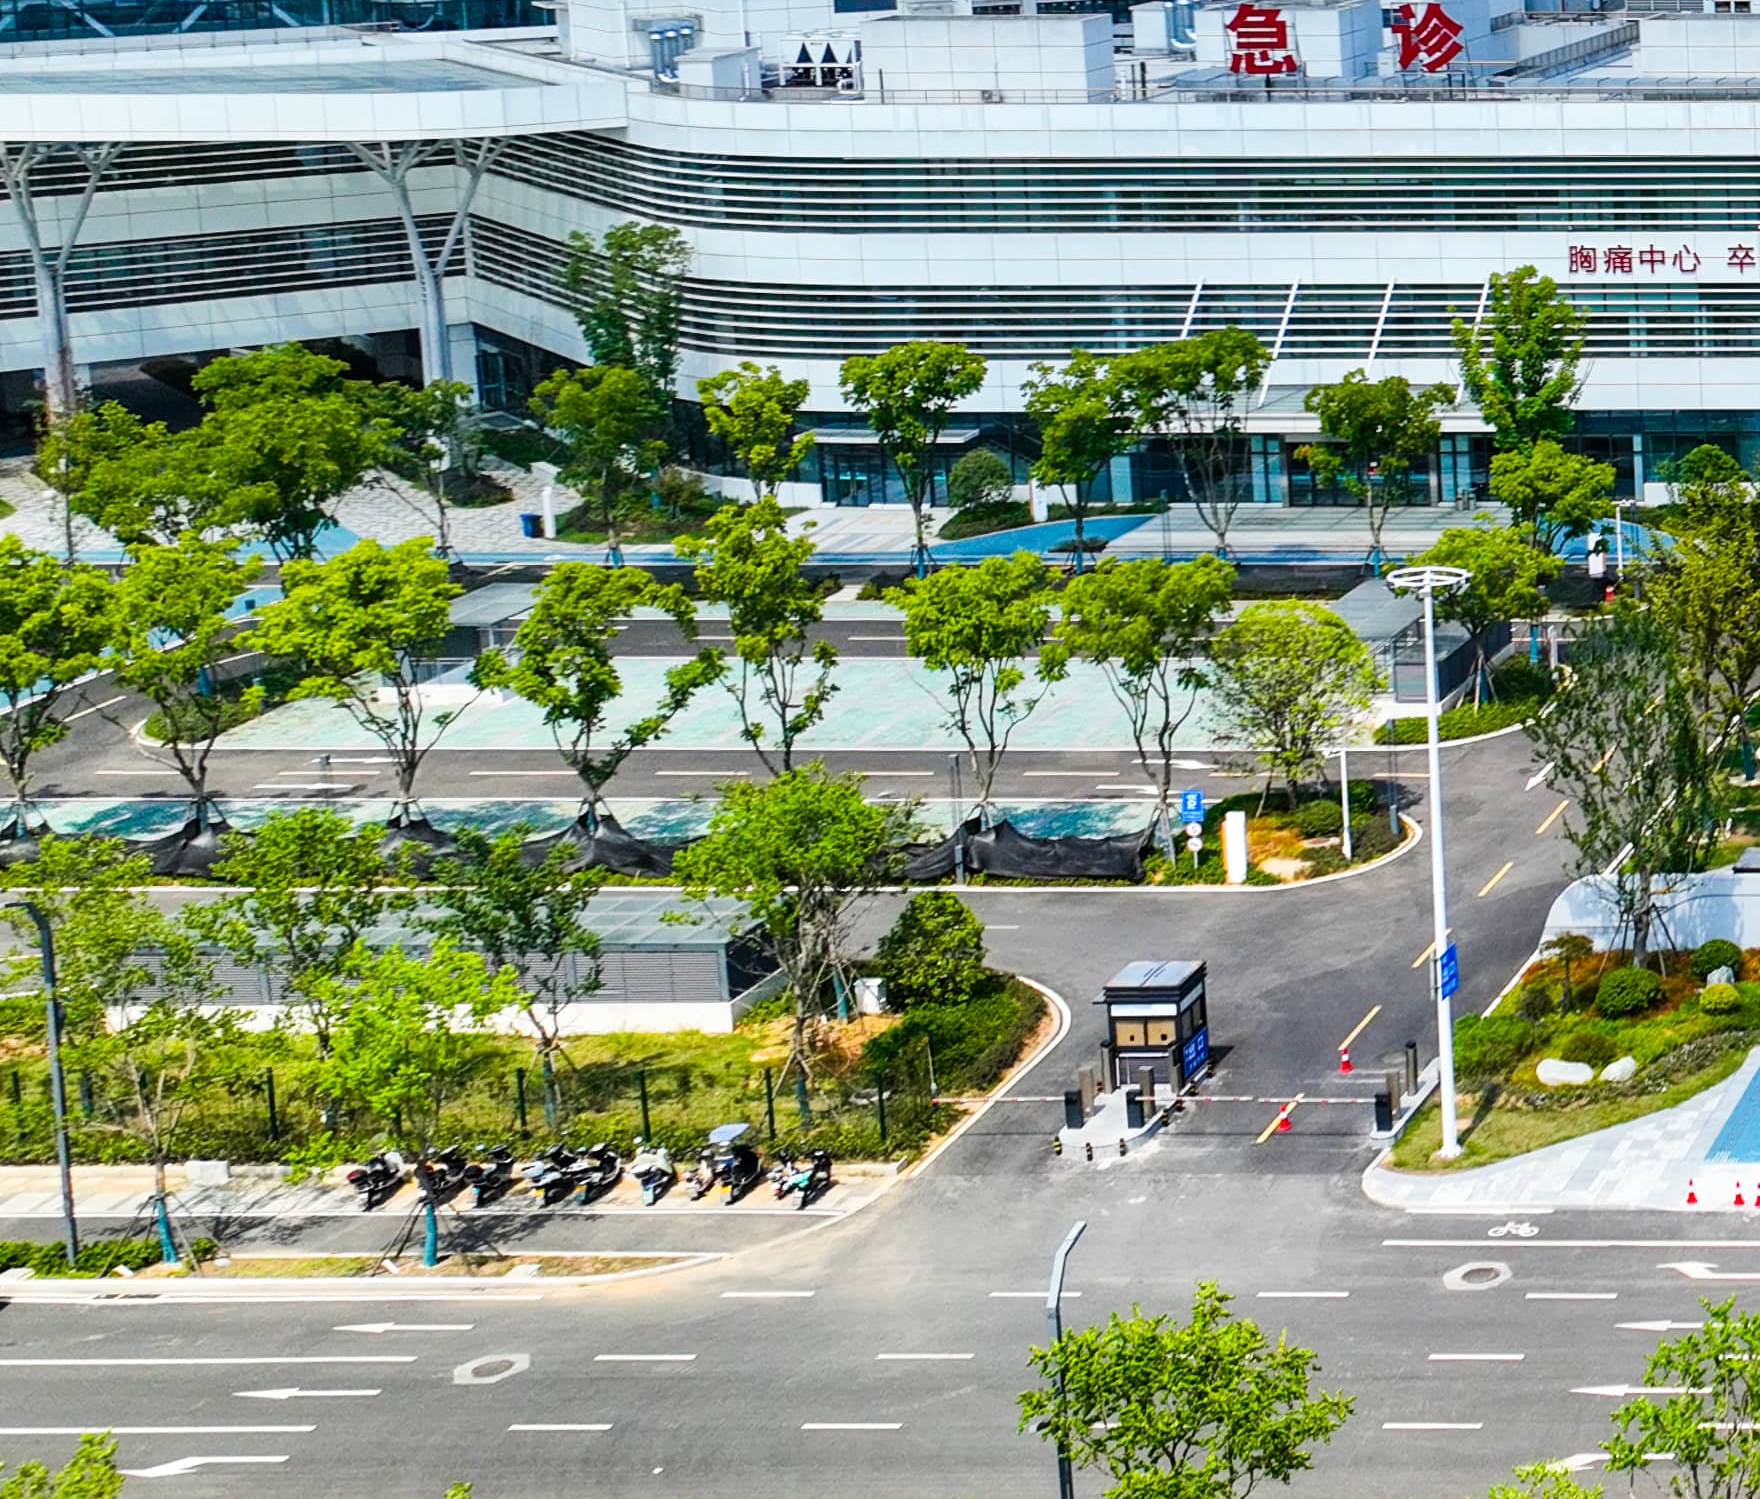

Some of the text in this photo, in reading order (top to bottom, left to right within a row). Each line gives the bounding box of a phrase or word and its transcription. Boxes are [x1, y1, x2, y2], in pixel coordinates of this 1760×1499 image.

[1226, 3, 1464, 74] 急诊
[1569, 245, 1701, 274] 胸痛中心
